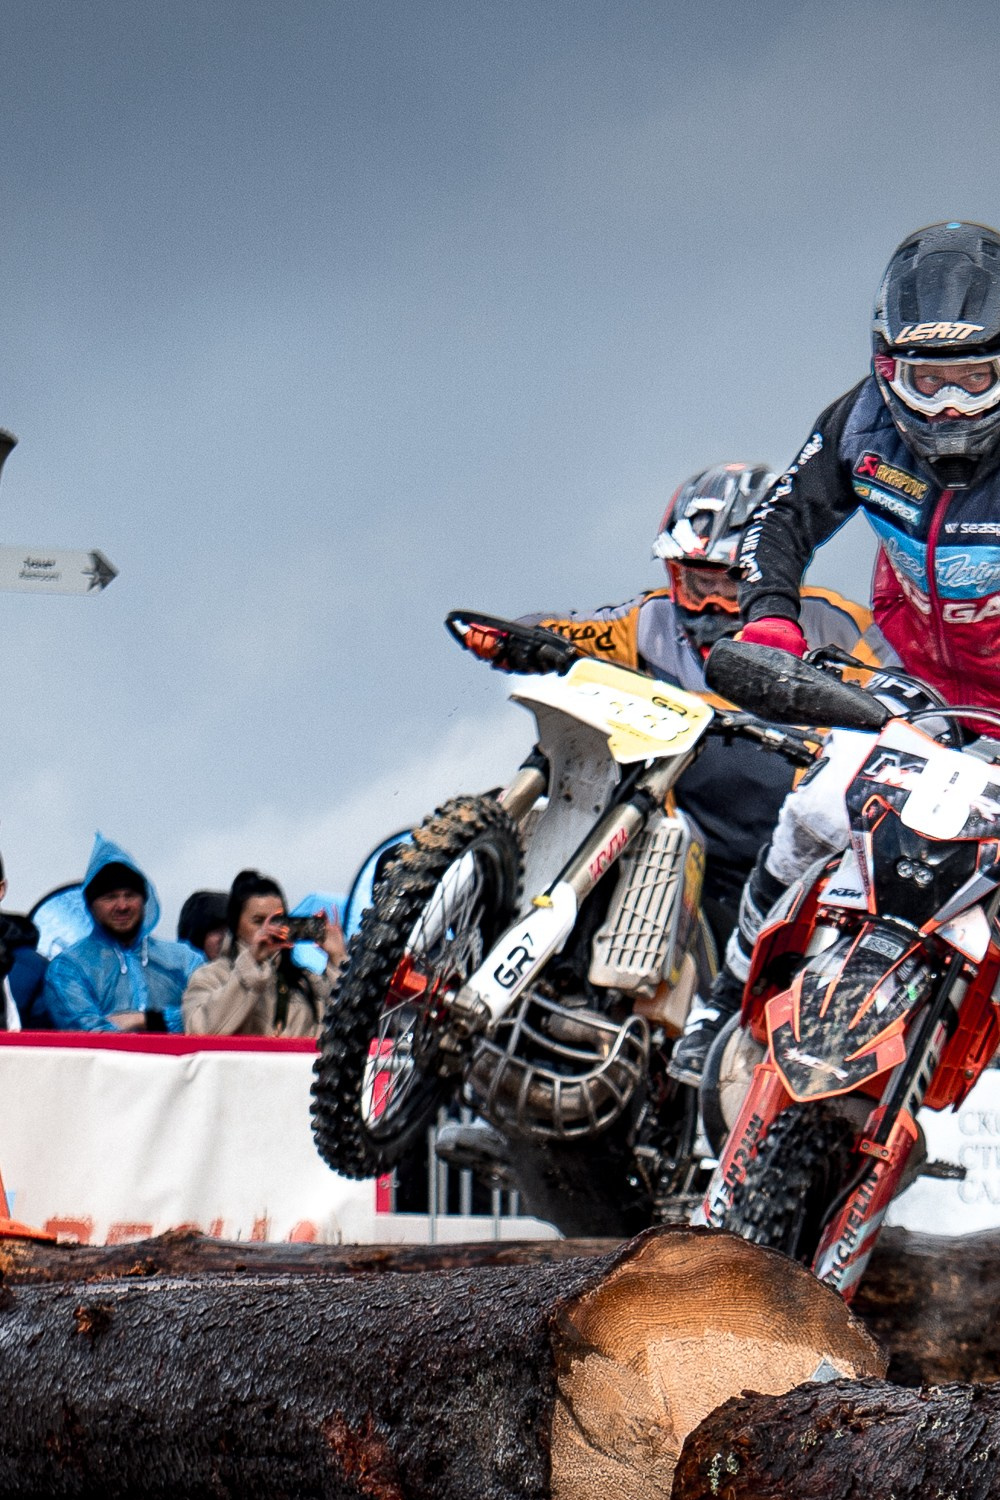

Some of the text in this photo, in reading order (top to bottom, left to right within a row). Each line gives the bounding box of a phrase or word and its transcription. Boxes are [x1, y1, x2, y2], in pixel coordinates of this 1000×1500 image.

[894, 321, 985, 344] LEATT
[869, 488, 920, 523] MOTOREX
[828, 887, 862, 899] KTM
[493, 932, 535, 989] GR7
